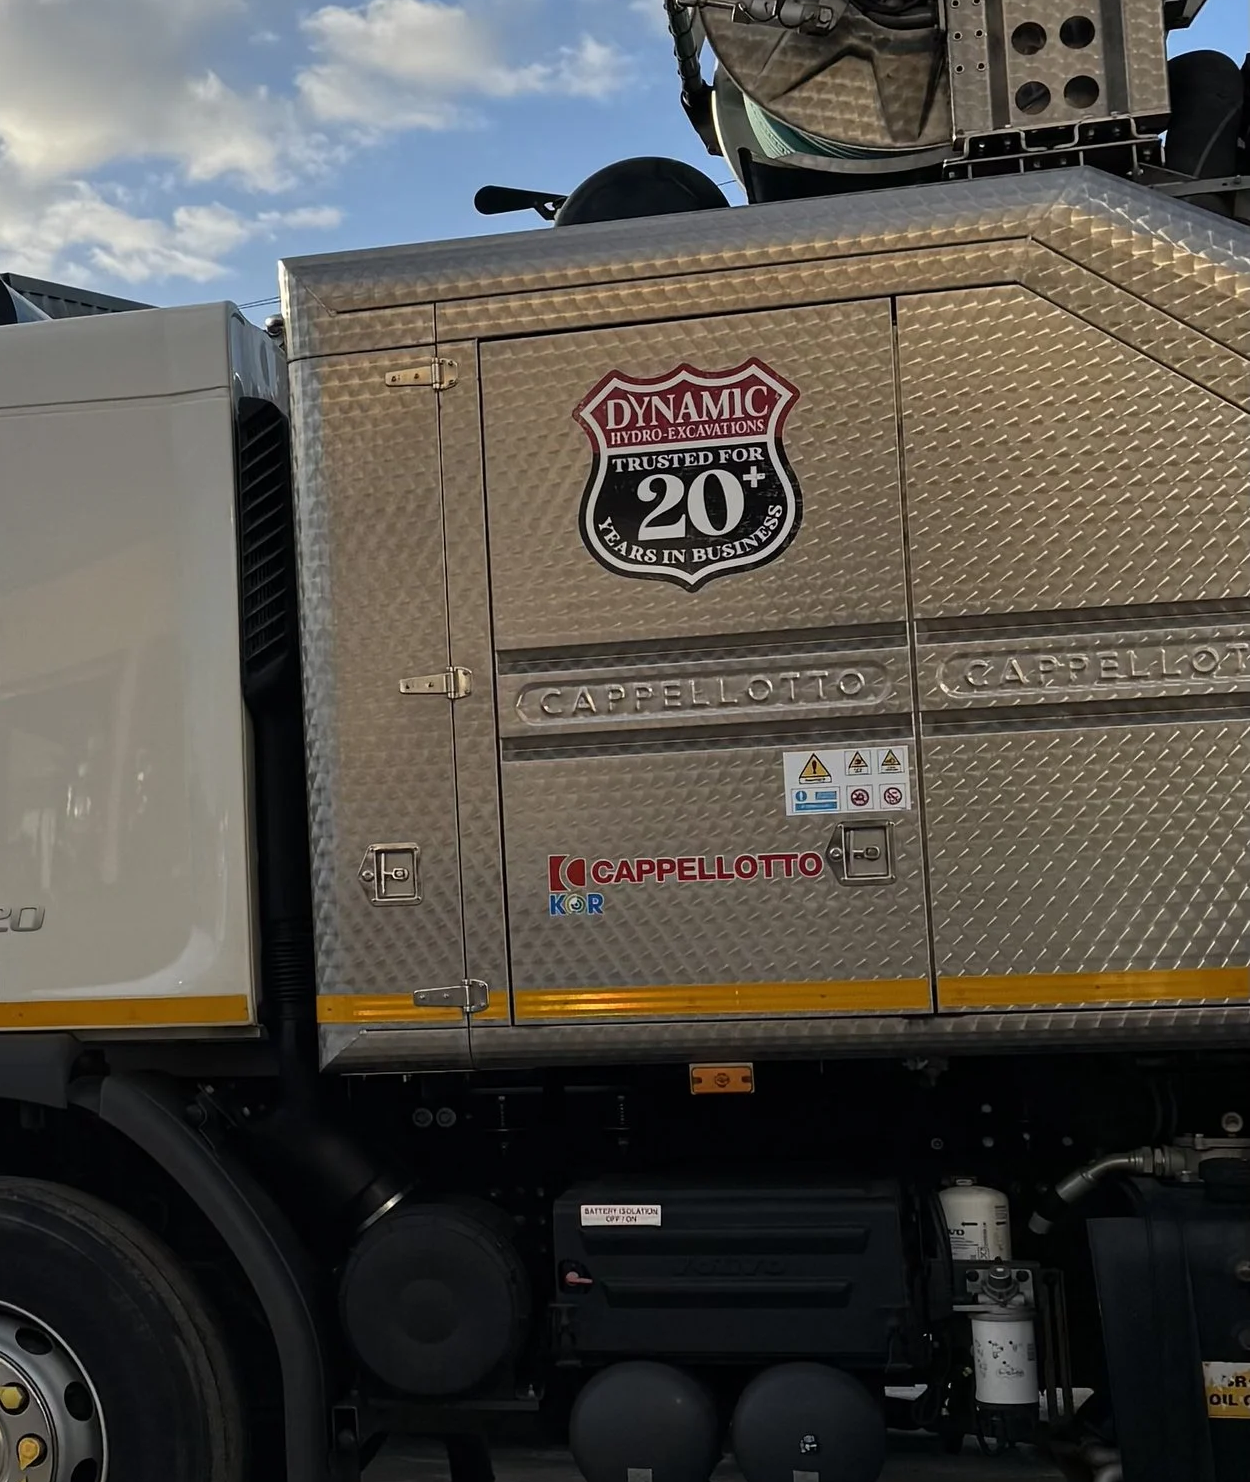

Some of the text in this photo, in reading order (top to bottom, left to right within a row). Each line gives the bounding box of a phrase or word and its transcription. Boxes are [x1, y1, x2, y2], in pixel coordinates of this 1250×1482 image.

[606, 386, 769, 430] DYNAMIC
[610, 419, 764, 445] HYDRO-EXCAVATIONS
[612, 447, 765, 473] TRUSTED FOR
[598, 504, 783, 564] YEARS IN BUSINESS
[540, 669, 866, 715] CAPPELLOTTO
[590, 852, 823, 884] CAPPELLOTTO
[584, 1207, 658, 1215] BATTERY ISOLATION
[625, 1215, 637, 1223] ON
[1209, 1393, 1239, 1406] OIL
